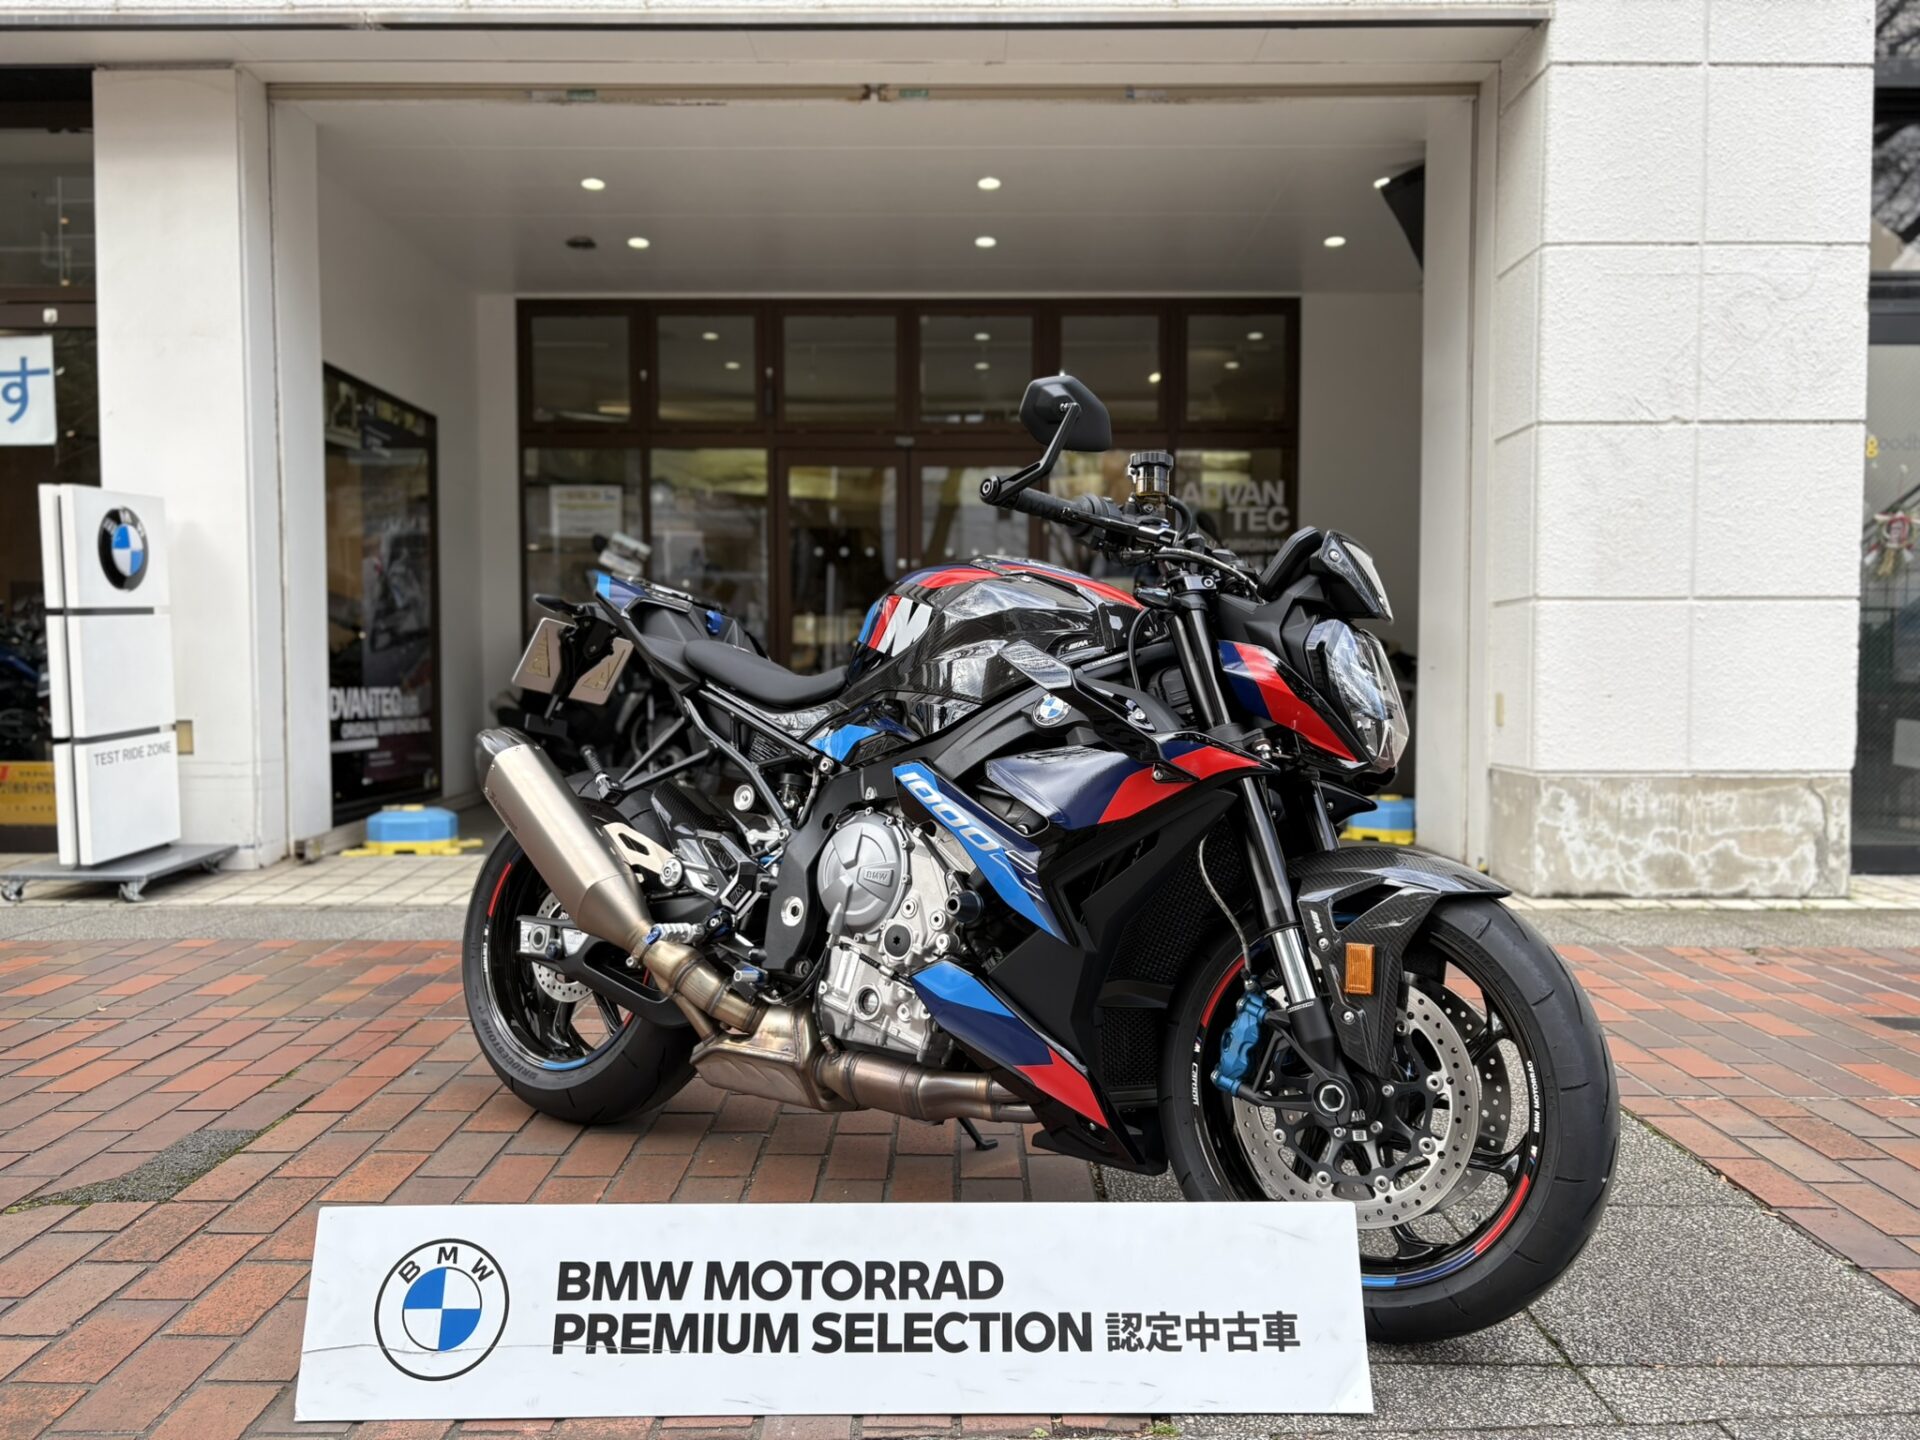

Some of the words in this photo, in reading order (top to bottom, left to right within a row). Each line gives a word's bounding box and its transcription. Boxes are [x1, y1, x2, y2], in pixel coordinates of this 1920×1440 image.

[1182, 480, 1286, 508] ADVAN
[1226, 506, 1290, 533] TEC
[94, 749, 120, 766] TEST
[122, 745, 145, 762] RIDE
[147, 741, 172, 757] ZONE
[899, 771, 1002, 851] 1000
[1526, 1060, 1541, 1110] MOTORRAD
[398, 1246, 495, 1284] BMW
[557, 1261, 694, 1301] BMW
[704, 1261, 1004, 1301] MOTORRAD
[552, 1313, 799, 1355] PREMIUM
[811, 1311, 1093, 1354] SELECTION
[1105, 1310, 1301, 1353] 認定中古車
